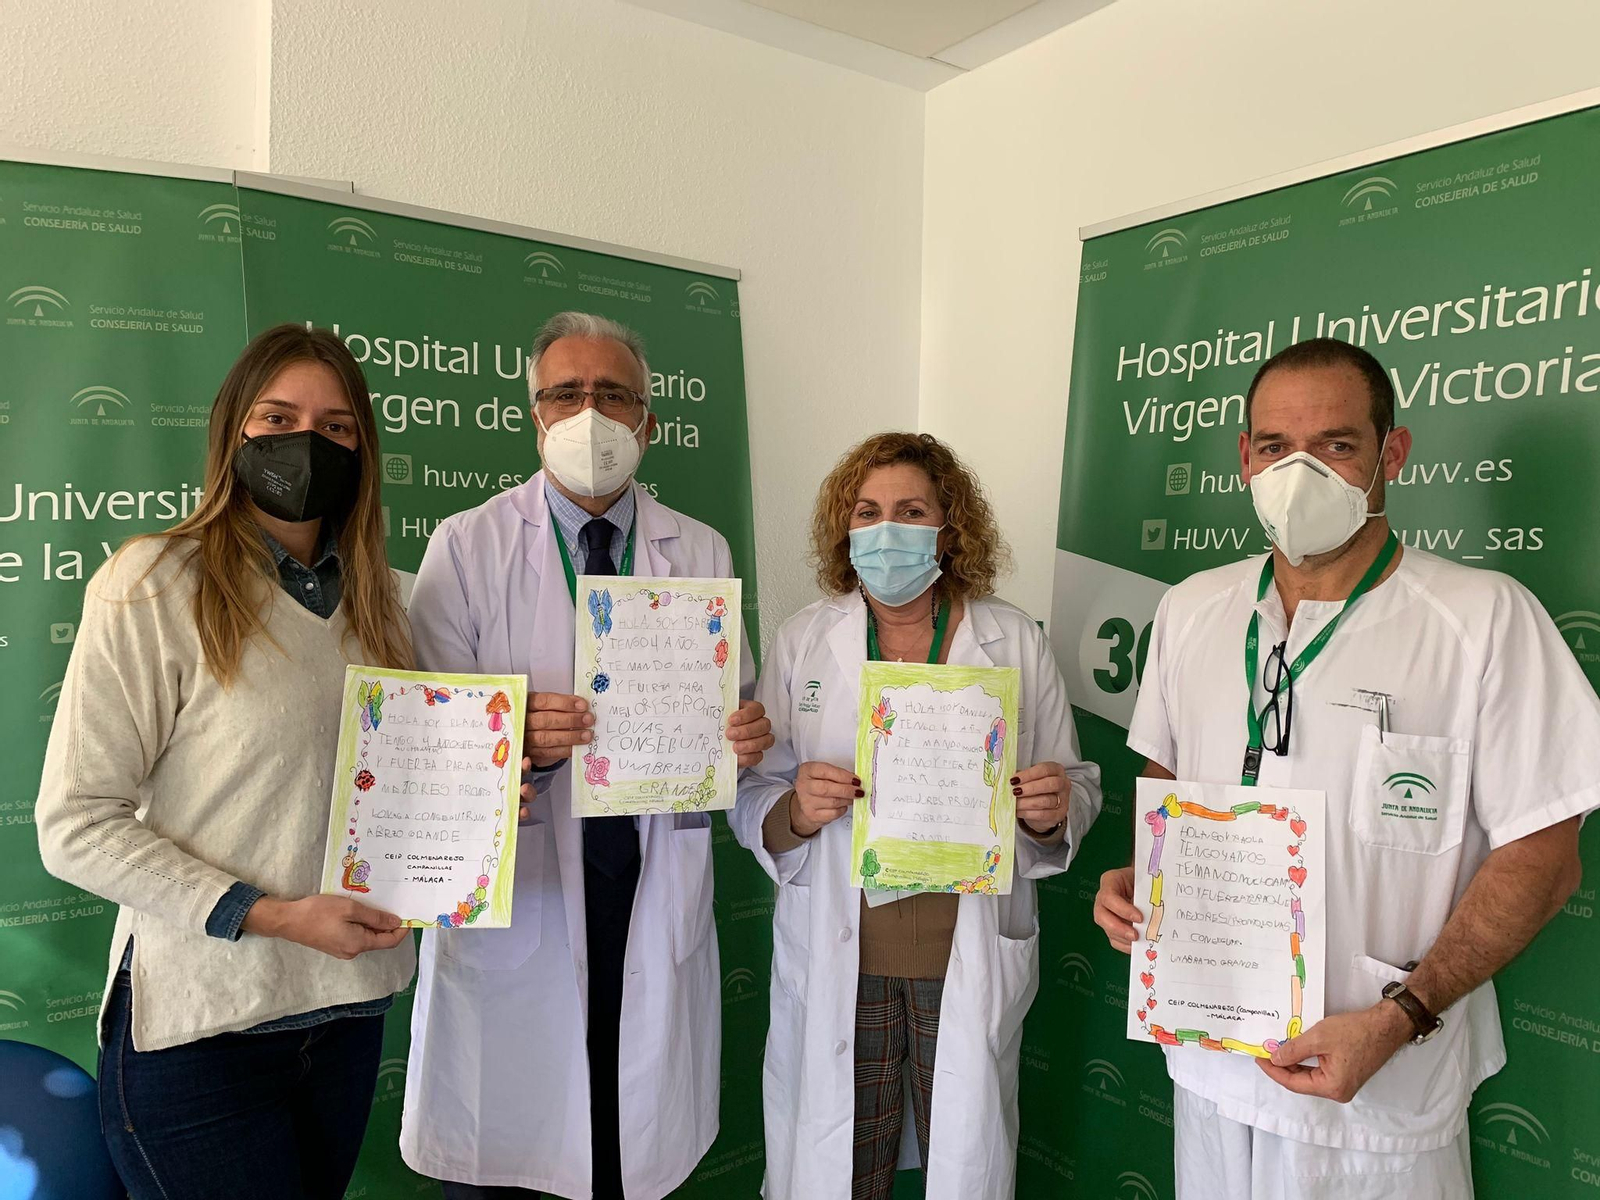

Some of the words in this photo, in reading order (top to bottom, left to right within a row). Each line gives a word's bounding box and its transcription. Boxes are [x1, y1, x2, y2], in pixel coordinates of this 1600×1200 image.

[1416, 177, 1452, 194] Servicio
[1454, 167, 1494, 185] Andaluz
[1496, 161, 1509, 174] de
[1512, 154, 1541, 171] Salud
[1482, 180, 1498, 194] DE
[1501, 172, 1539, 190] SALUD
[23, 201, 60, 214] Servicio
[63, 205, 100, 218] Andaluz
[103, 208, 115, 219] de
[117, 209, 142, 220] Salud
[91, 222, 106, 232] DE
[108, 223, 142, 235] SALUD
[254, 215, 277, 228] Salud
[246, 228, 276, 241] SALUD
[1201, 231, 1227, 244] Servicio
[1228, 224, 1258, 238] Andaluz
[1259, 219, 1269, 231] de
[1270, 215, 1292, 228] Salud
[1248, 235, 1260, 248] DE
[1262, 229, 1290, 245] SALUD
[393, 239, 421, 252] Servicio
[424, 244, 451, 257] Andaluz
[452, 249, 462, 258] de
[464, 250, 483, 262] Salud
[445, 260, 456, 270] DE
[457, 261, 482, 274] SALUD
[1092, 259, 1109, 270] Salud
[578, 271, 600, 283] Servicio
[601, 275, 626, 288] Andaluz
[626, 280, 635, 288] de
[636, 280, 651, 291] Salud
[1085, 272, 1107, 283] SALUD
[620, 290, 629, 299] DE
[630, 291, 651, 302] SALUD
[90, 304, 125, 316] Servicio
[127, 306, 164, 319] Andaluz
[166, 309, 178, 320] de
[179, 310, 204, 321] Salud
[1291, 268, 1600, 347] Universitari
[154, 322, 169, 332] DE
[171, 322, 204, 334] SALUD
[306, 320, 478, 377] ospital
[1116, 320, 1275, 382] Hospital
[151, 403, 184, 413] Servicio
[475, 397, 523, 432] de
[1123, 394, 1245, 442] Virgen
[424, 464, 523, 490] huvv.es
[43, 543, 83, 581] la
[655, 616, 678, 628] SOY
[608, 661, 622, 671] TE
[615, 679, 623, 694] Y
[905, 702, 935, 714] HOLA
[388, 713, 418, 725] HOLA
[674, 724, 683, 733] A
[898, 736, 911, 748] TE
[1382, 803, 1399, 811] JUNTA
[21, 897, 62, 911] Andaluz
[63, 895, 76, 905] de
[52, 911, 67, 922] DE
[69, 905, 104, 919] SALUD
[1172, 929, 1179, 939] A
[46, 995, 83, 1009] Servicio
[1513, 999, 1556, 1021] Servicio
